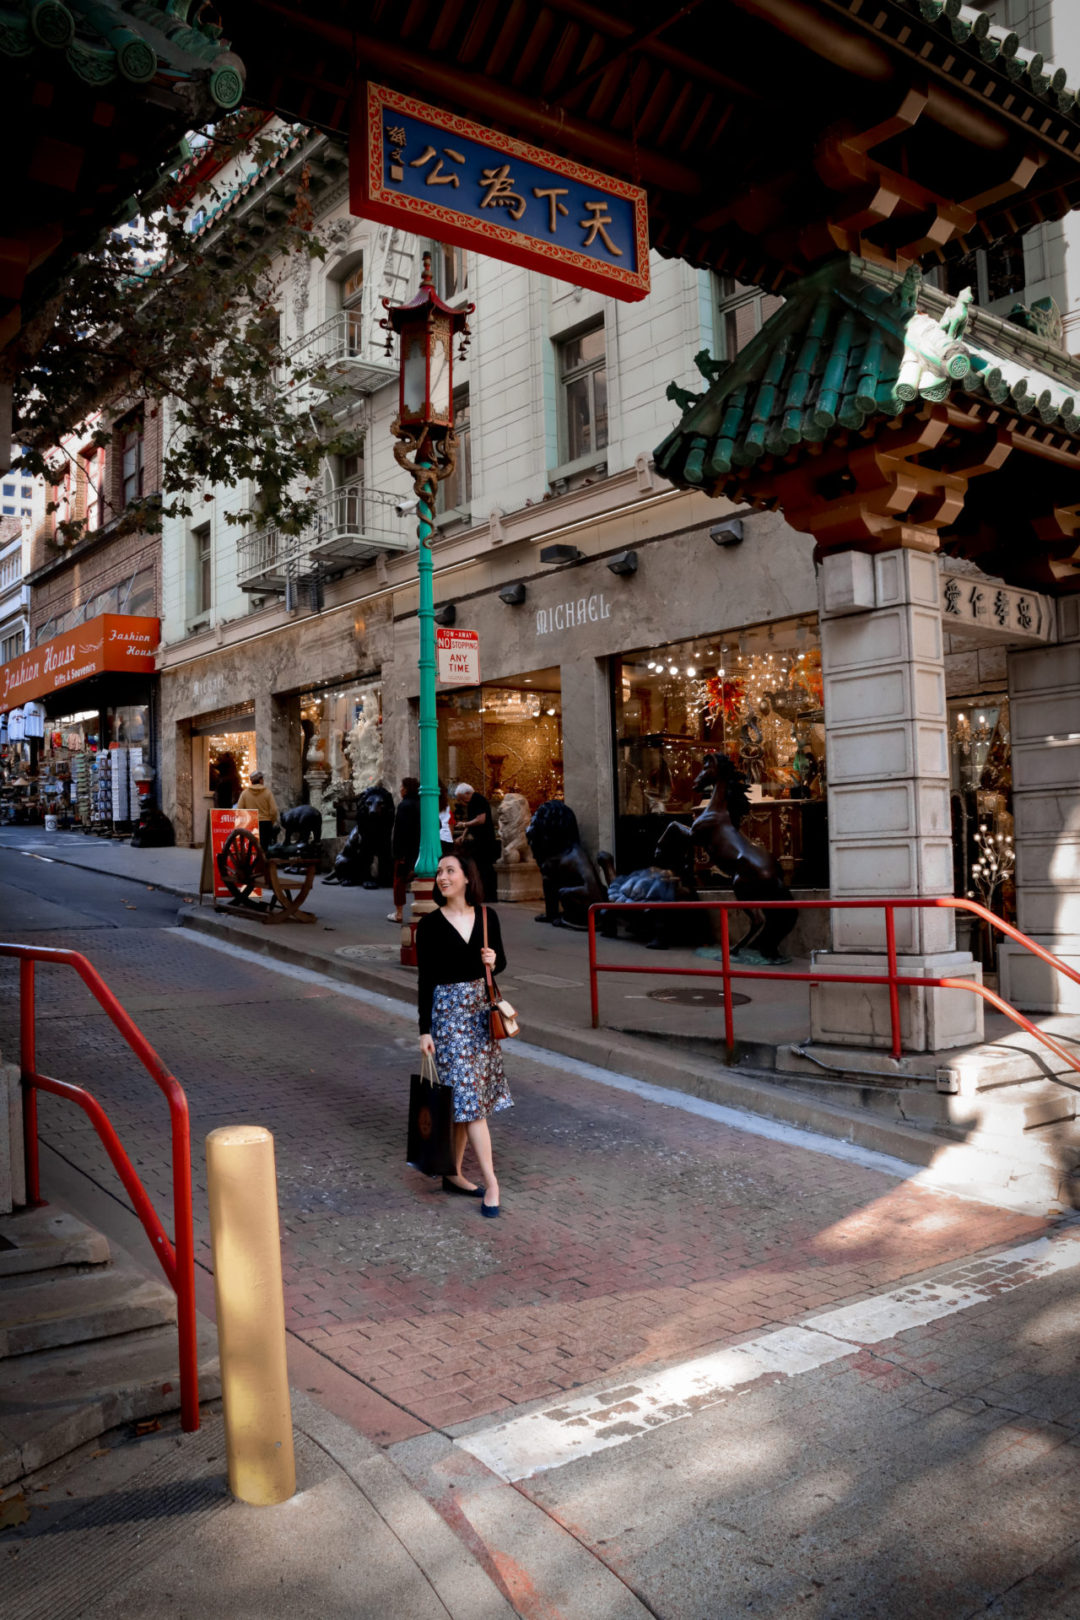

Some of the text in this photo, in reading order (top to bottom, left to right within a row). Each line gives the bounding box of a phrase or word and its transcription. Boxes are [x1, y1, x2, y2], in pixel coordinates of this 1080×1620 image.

[536, 594, 611, 635] MICHAEL
[109, 630, 151, 642] Fashion
[438, 638, 477, 649] NO STOPPING
[126, 645, 152, 657] Hous
[450, 654, 468, 662] ANY
[3, 645, 76, 698] Fashion House
[449, 664, 470, 673] TIME
